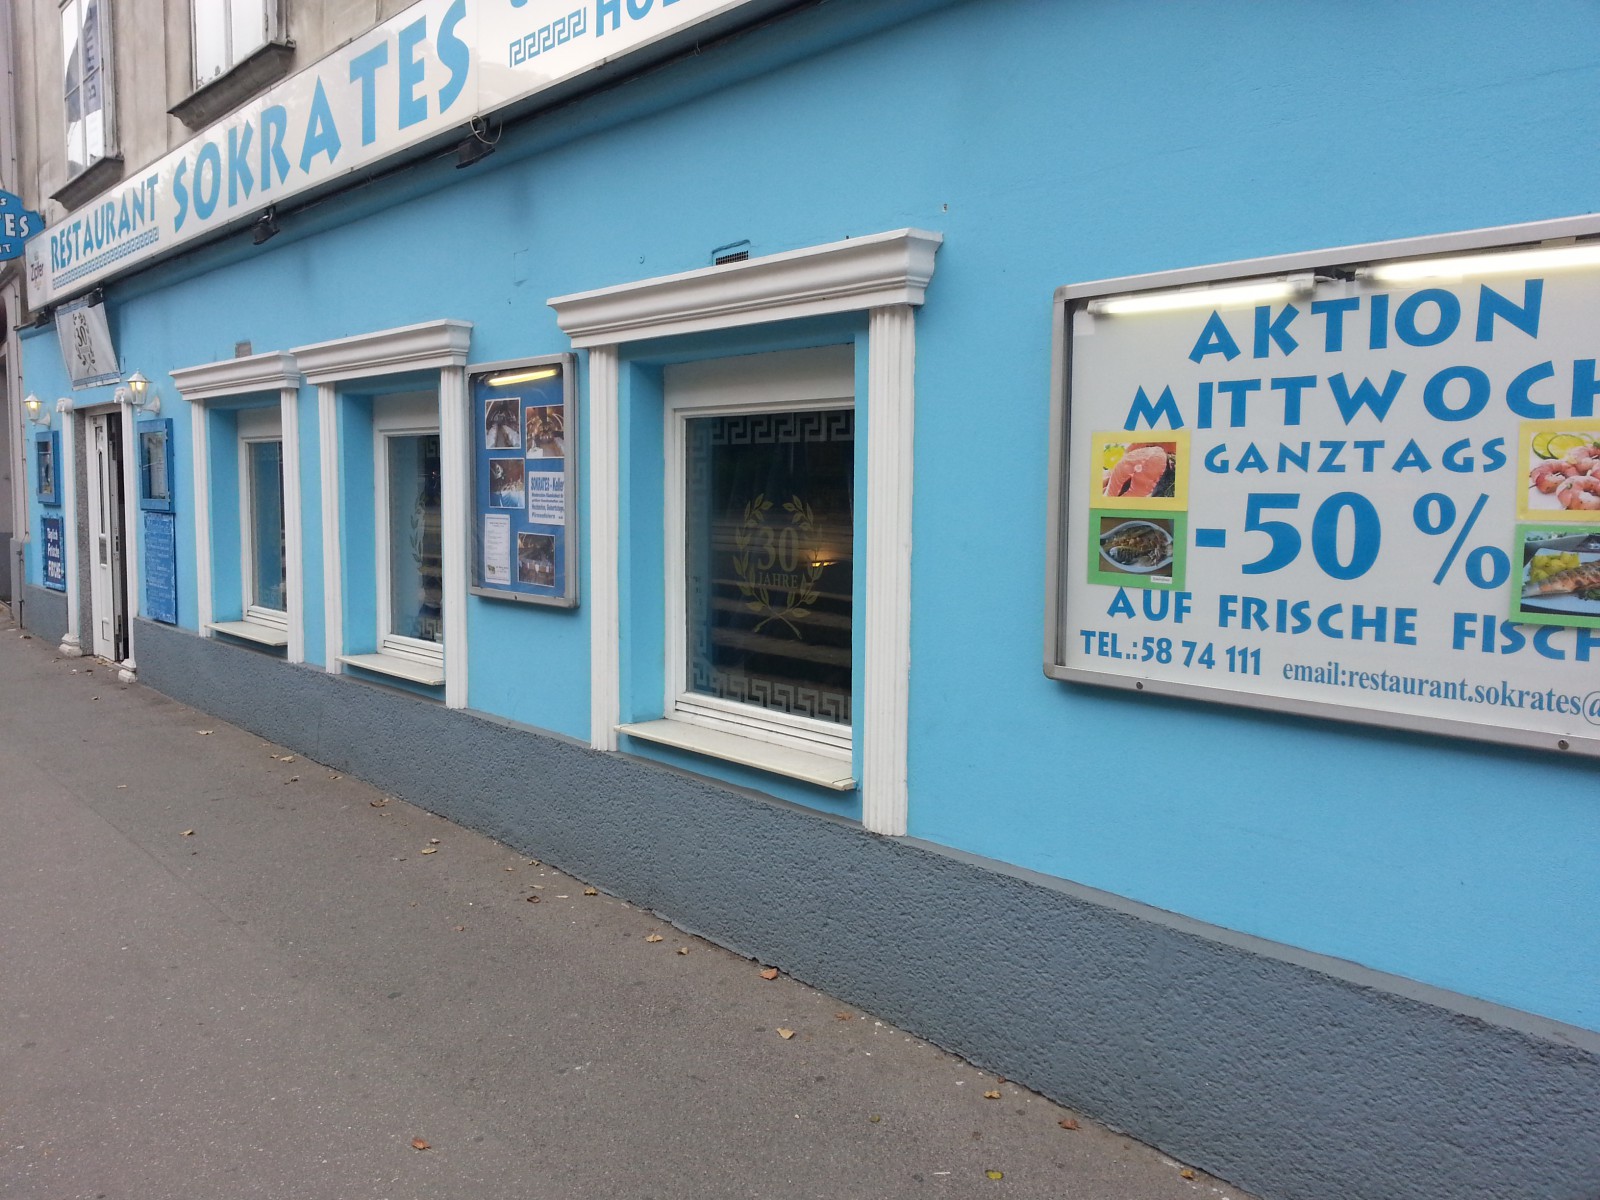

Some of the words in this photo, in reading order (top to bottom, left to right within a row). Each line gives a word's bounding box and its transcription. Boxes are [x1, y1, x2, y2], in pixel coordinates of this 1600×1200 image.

[51, 173, 158, 273] RESTAURANT
[173, 0, 470, 232] SOKRATES
[0, 213, 29, 238] ES
[76, 326, 88, 347] 30
[1189, 279, 1544, 363] AKTION
[1124, 358, 1600, 430] MITTWOCH
[1204, 438, 1507, 473] GANZTAGS
[757, 526, 799, 572] 30
[1195, 492, 1382, 580] -50
[1413, 493, 1511, 590] %
[758, 571, 799, 589] JAHRE
[1107, 587, 1192, 623] AUF
[1218, 595, 1417, 645] FRISCHE
[1453, 612, 1600, 662] FISCH
[1181, 640, 1216, 670] 74
[1225, 645, 1261, 676] 111
